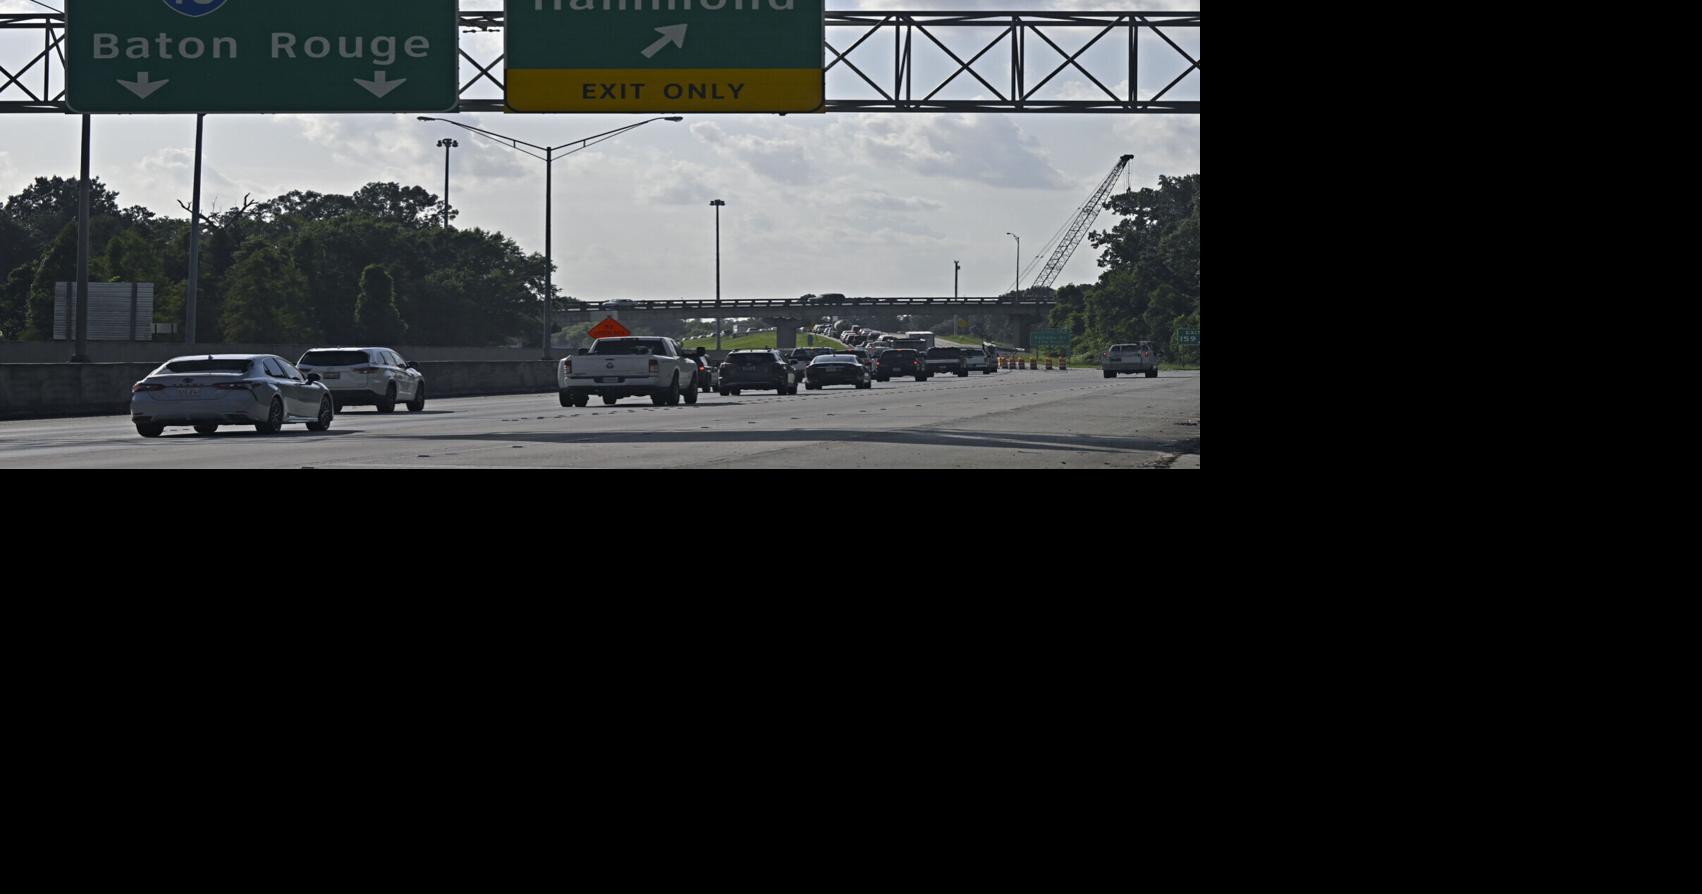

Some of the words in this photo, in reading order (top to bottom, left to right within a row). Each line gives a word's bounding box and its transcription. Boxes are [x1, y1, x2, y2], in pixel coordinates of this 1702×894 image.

[93, 33, 237, 59] Baton
[271, 33, 430, 66] Rouge
[582, 83, 645, 100] EXIT
[663, 83, 745, 100] ONLY
